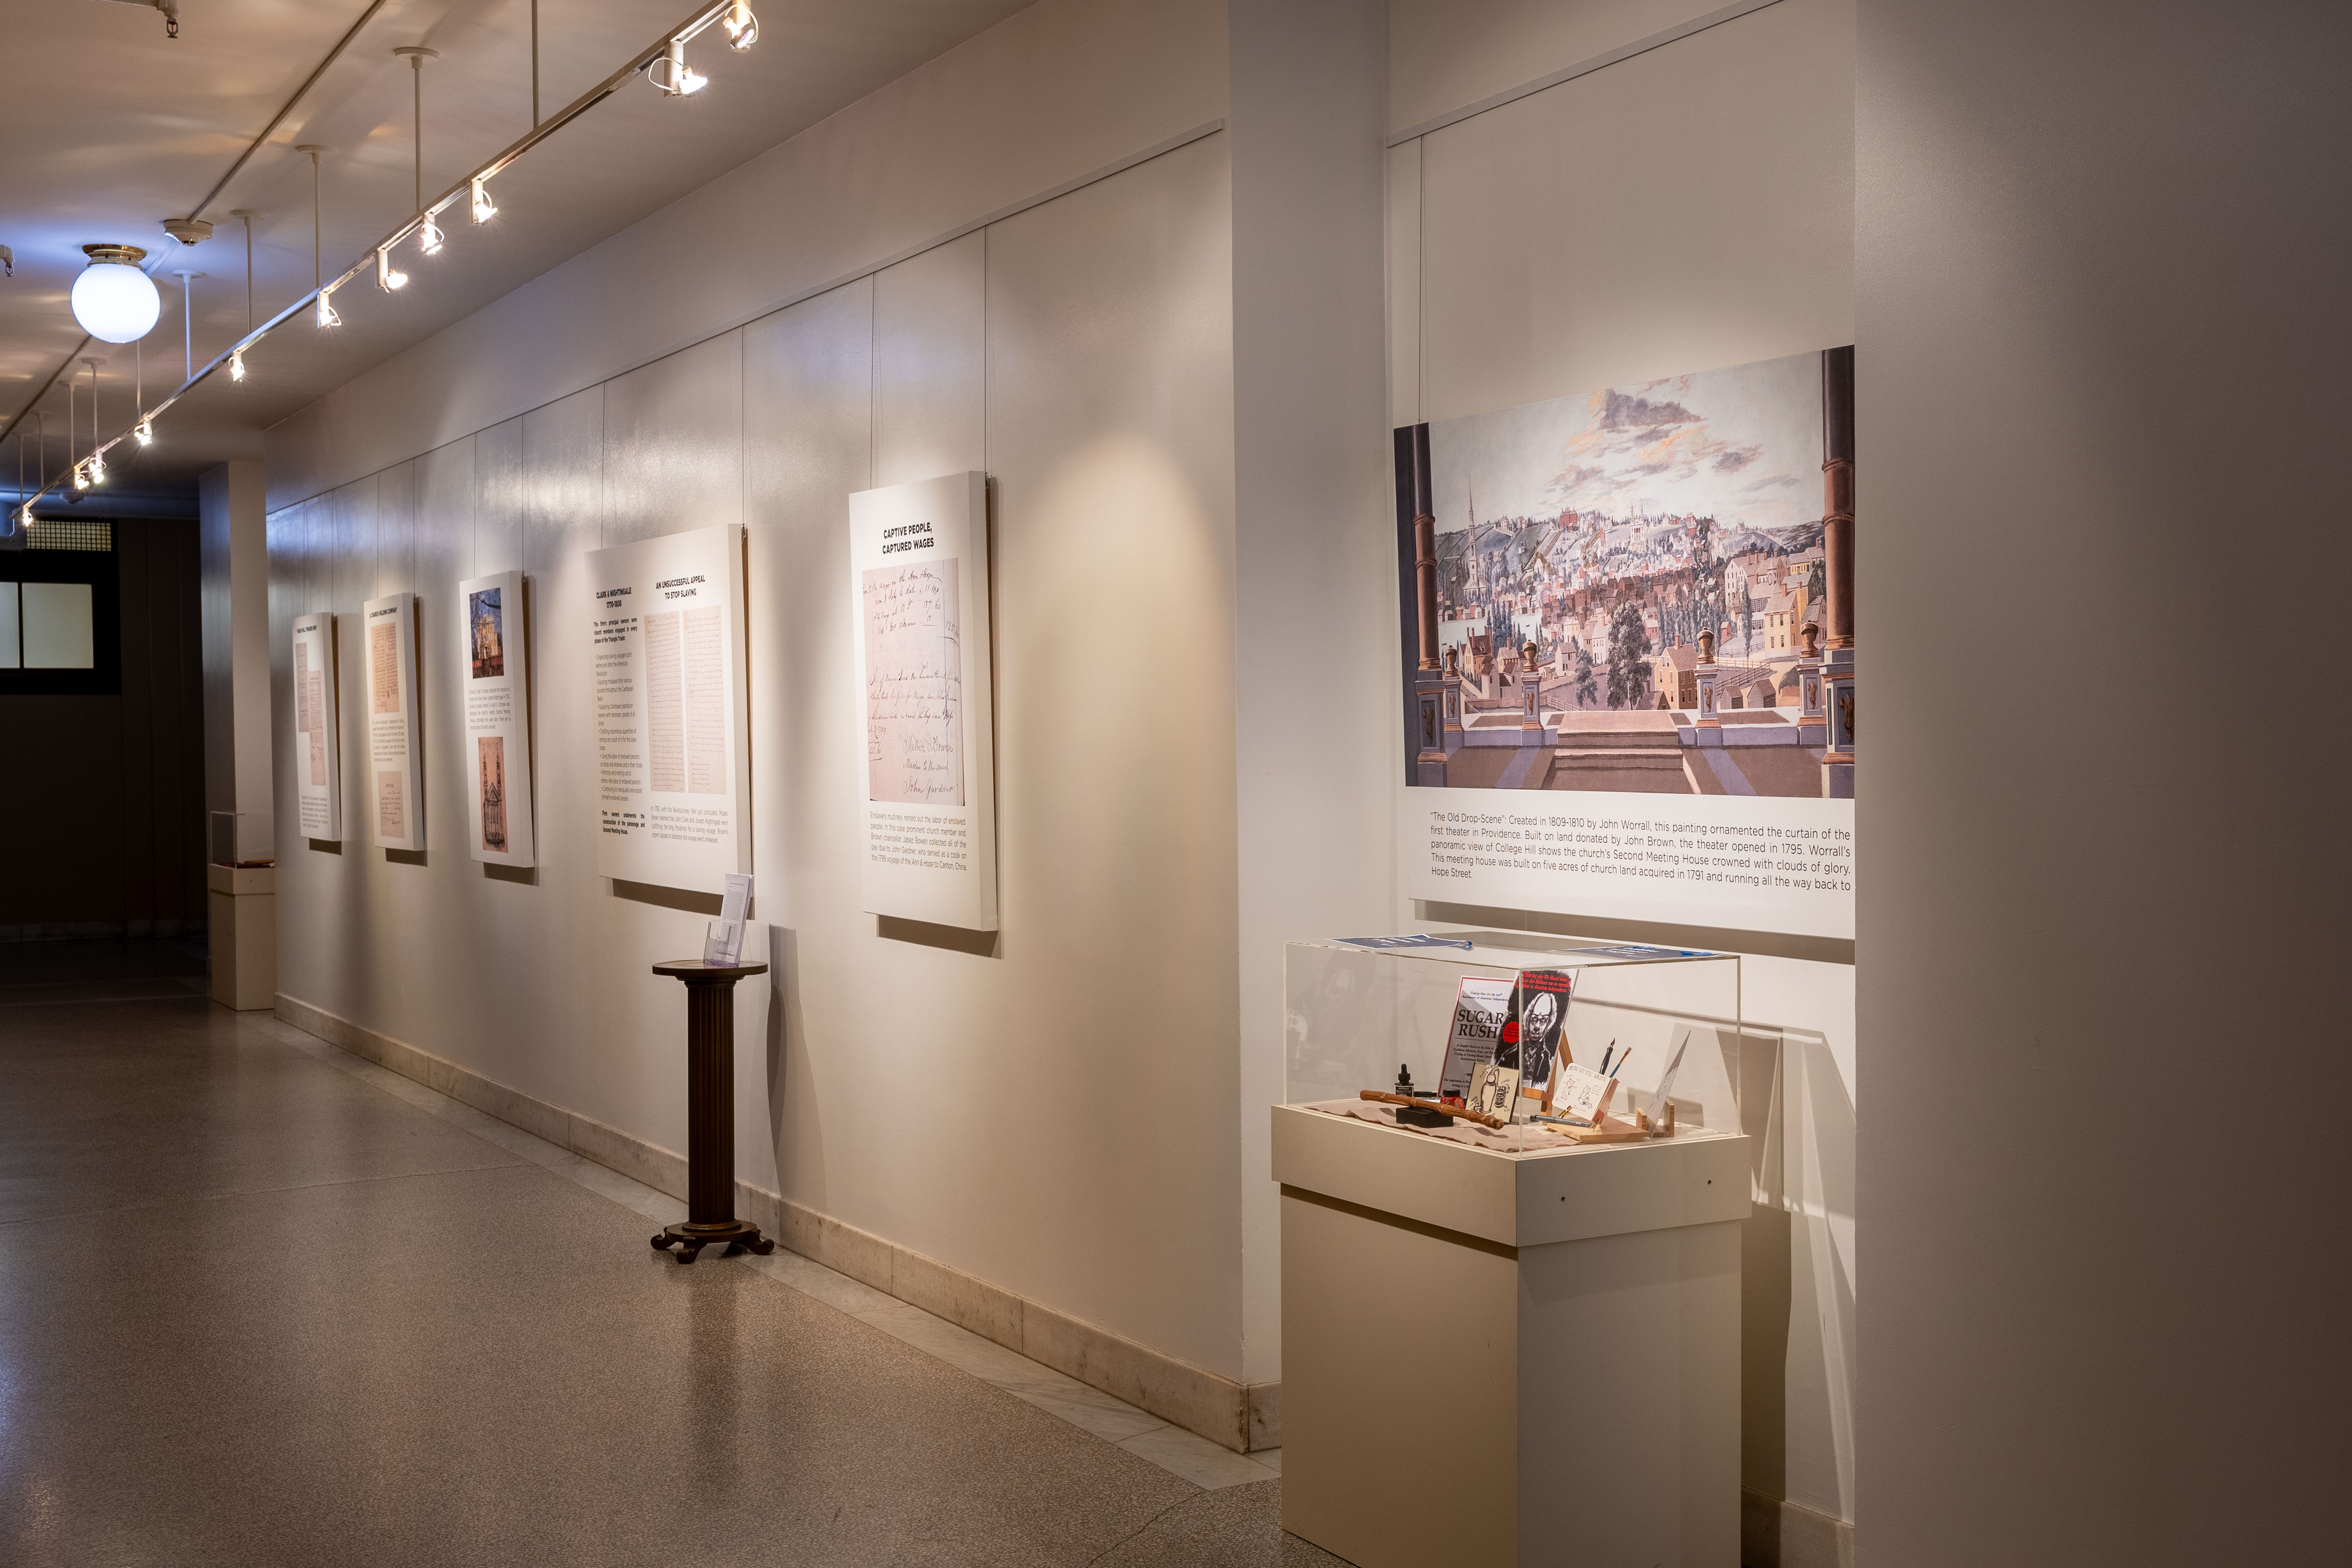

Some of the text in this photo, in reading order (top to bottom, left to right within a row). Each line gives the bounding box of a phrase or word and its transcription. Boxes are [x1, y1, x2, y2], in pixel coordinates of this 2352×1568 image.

[884, 522, 932, 539] CAPTIVE PEOPLE,
[883, 538, 934, 554] CAPTURED WAGES
[662, 578, 689, 589] UNSUCCESSFUL
[691, 575, 705, 584] APPEAL
[596, 590, 607, 599] CLARK
[610, 587, 631, 597] NIGHTINGALE
[681, 589, 696, 597] SLAVING
[904, 776, 924, 793] John
[870, 811, 886, 820] Enslavers
[1448, 813, 1459, 821] Old
[1509, 815, 1537, 825] Created
[1540, 816, 1546, 825] in
[1549, 817, 1584, 827] 1809-1810
[1587, 818, 1596, 830] by
[1599, 819, 1618, 828] John
[1621, 820, 1652, 831] Worrall,
[1655, 821, 1669, 831] this
[1673, 823, 1707, 835] painting
[1711, 826, 1763, 836] ornamented
[1767, 826, 1782, 837] the
[1786, 828, 1817, 838] curtain
[1822, 829, 1831, 839] of
[1835, 829, 1850, 840] the
[1431, 825, 1443, 835] first
[1446, 826, 1470, 836] theater
[1473, 828, 1478, 836] in
[1482, 828, 1521, 839] Providence.
[1526, 830, 1541, 840] Built
[1557, 832, 1572, 841] land
[1576, 833, 1607, 843] donated
[1612, 834, 1620, 846] by
[1625, 836, 1643, 845] John
[1648, 836, 1675, 848] Brown,
[1680, 838, 1693, 848] the
[1697, 839, 1728, 850] theater
[1732, 842, 1765, 852] opened
[1770, 843, 1777, 853] in
[1782, 844, 1804, 854] 1795.
[1432, 841, 1465, 850] panoramic
[1468, 841, 1483, 851] view
[1486, 842, 1493, 851] of
[1496, 843, 1521, 854] College
[1525, 845, 1535, 854] Hill
[1539, 846, 1561, 855] shows
[1564, 847, 1575, 856] the
[1614, 850, 1642, 860] Second
[1646, 852, 1679, 865] Meeting
[1683, 854, 1709, 865] House
[1712, 858, 1750, 868] crowned
[1754, 858, 1772, 869] with
[1777, 860, 1807, 871] clouds
[1811, 862, 1820, 872] of
[1824, 862, 1850, 875] glory.
[940, 861, 954, 870] Canton,
[1431, 853, 1444, 862] This
[1447, 855, 1473, 866] meeting
[1476, 856, 1496, 865] house
[1514, 858, 1530, 868] built
[1543, 860, 1556, 870] five
[1581, 863, 1588, 872] of
[1591, 863, 1617, 874] church
[1620, 865, 1636, 875] land
[1639, 868, 1674, 878] acquired
[1678, 869, 1684, 879] in
[1687, 870, 1703, 880] 1791
[1707, 872, 1722, 881] and
[1726, 874, 1759, 886] running
[1762, 875, 1772, 885] all
[1775, 876, 1789, 886] the
[1793, 880, 1811, 890] way
[1815, 878, 1837, 890] back
[1841, 880, 1850, 891] to
[1432, 867, 1472, 878] Hope Street.
[1458, 1010, 1504, 1024] SUGAR
[1458, 1024, 1499, 1038] RUSH
[1594, 1074, 1607, 1082] WRITE
